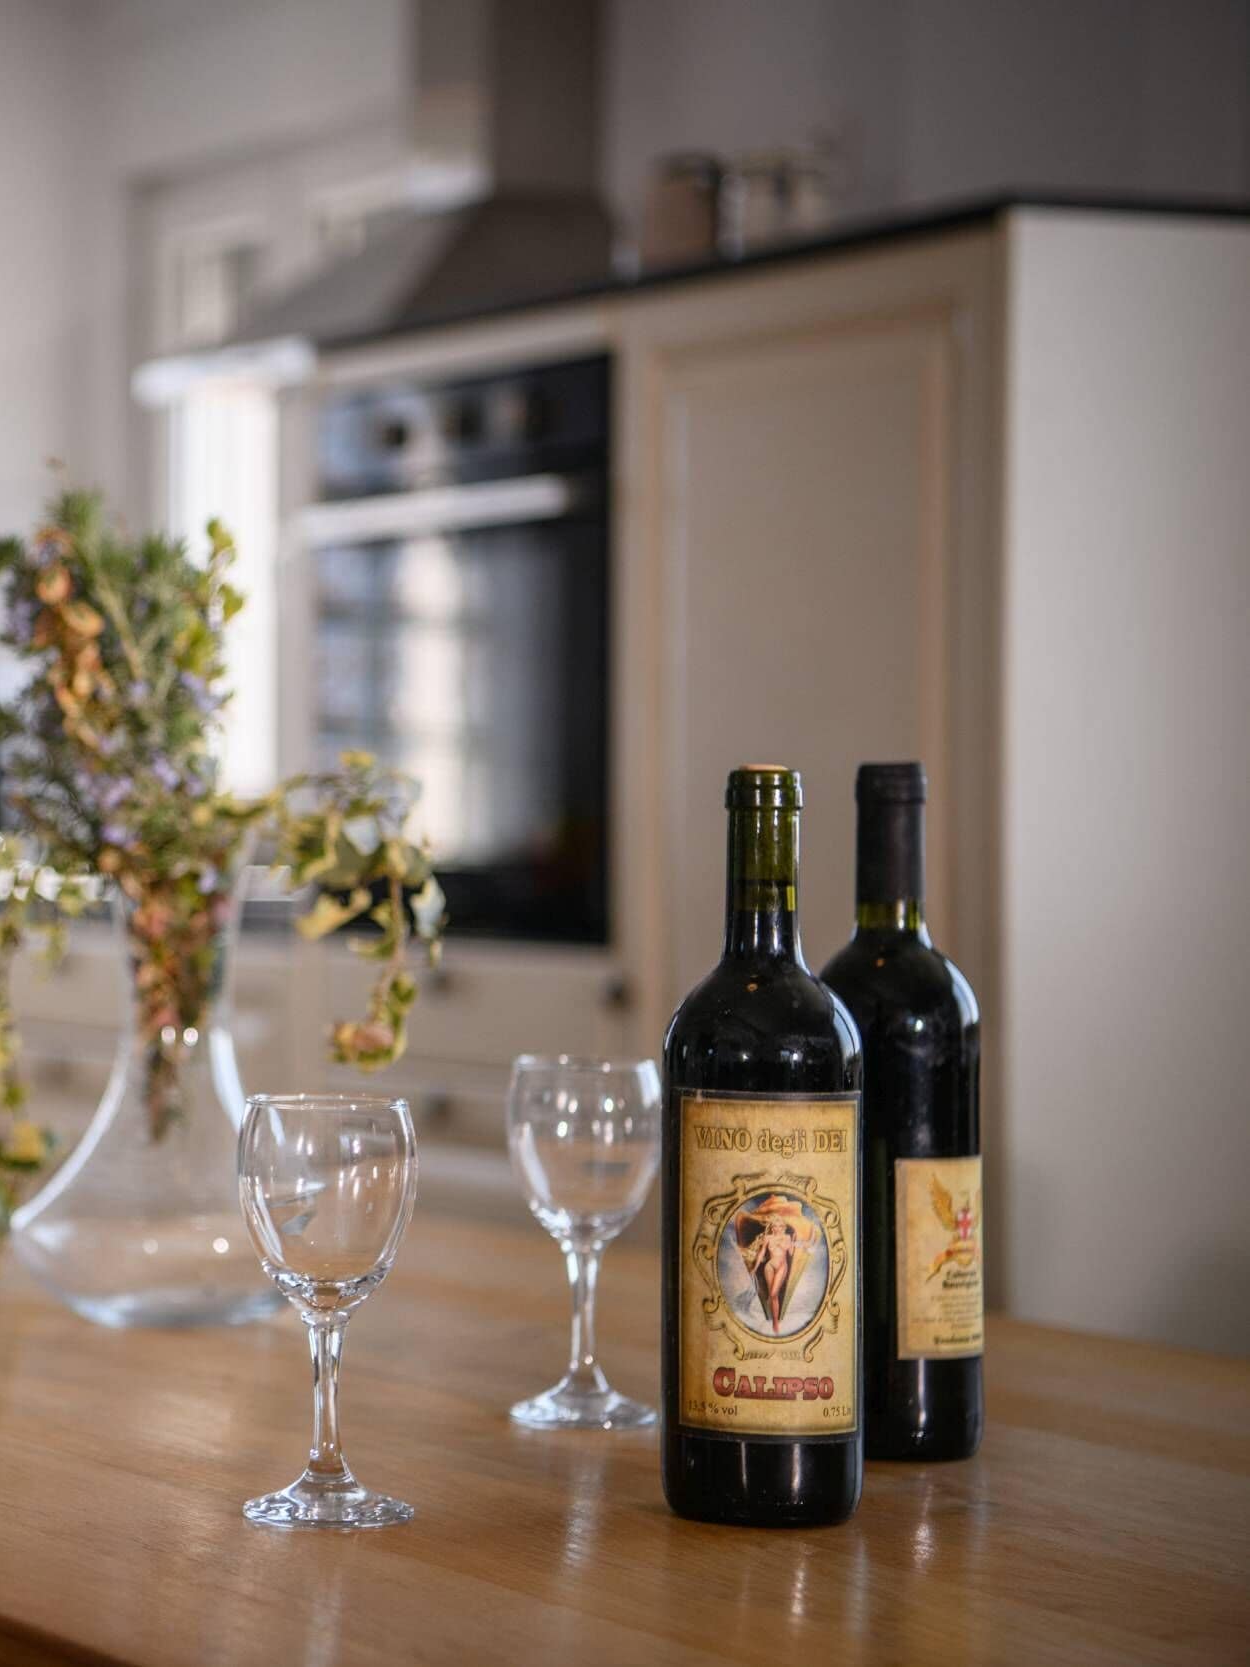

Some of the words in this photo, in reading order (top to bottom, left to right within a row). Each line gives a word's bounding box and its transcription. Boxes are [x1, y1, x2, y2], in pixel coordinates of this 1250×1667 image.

[694, 1126, 752, 1151] VINO
[757, 1128, 808, 1159] degli
[813, 1129, 848, 1153] DEI
[713, 1366, 835, 1401] CALIPSO
[721, 1405, 738, 1416] vol
